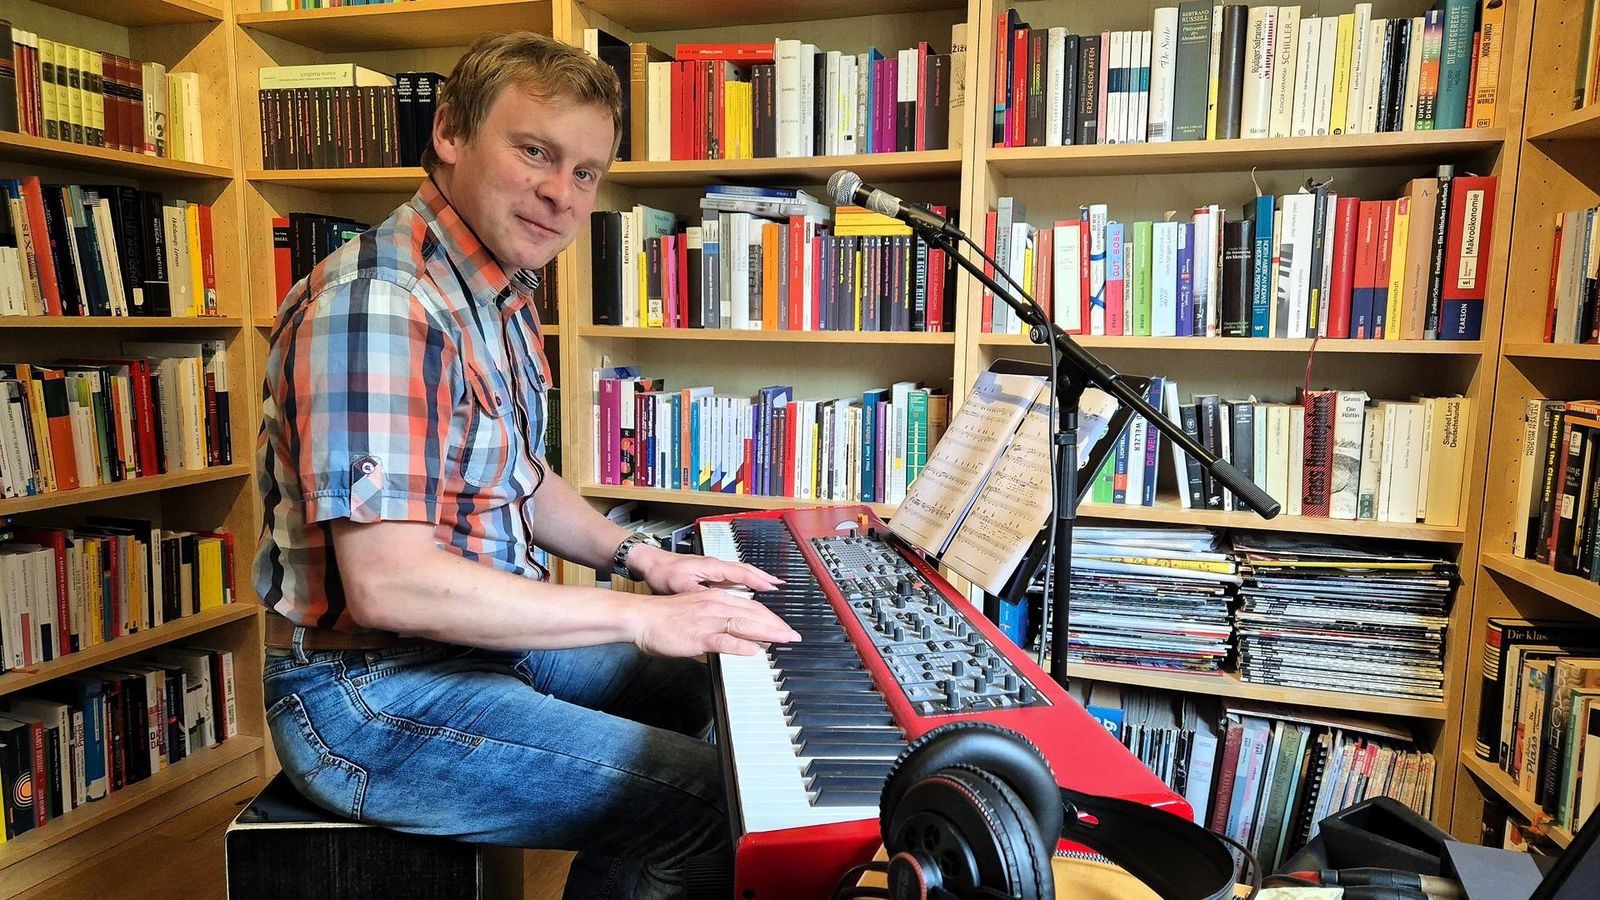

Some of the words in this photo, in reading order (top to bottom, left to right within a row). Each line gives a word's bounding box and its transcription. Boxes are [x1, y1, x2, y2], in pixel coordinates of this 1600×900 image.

[1182, 9, 1210, 17] BERTRAND
[1182, 15, 1209, 23] RUSSELL
[1252, 20, 1263, 50] Safranski
[1448, 6, 1460, 51] AUFGEREGTE
[1457, 6, 1470, 58] GESELLSCHAFT
[1483, 23, 1492, 41] COMIC
[1281, 22, 1293, 65] SCHILLER
[1481, 42, 1490, 58] BOOK
[1088, 47, 1096, 69] AFFEN
[1251, 50, 1263, 74] Rüdiger
[1446, 51, 1456, 65] DIE
[1440, 183, 1449, 209] Lehrbuch
[153, 217, 161, 245] MUSICAL
[1438, 209, 1447, 235] kritisches
[1465, 193, 1480, 255] Makroökonomie
[1112, 261, 1120, 276] GUT
[1434, 249, 1443, 275] Evolution
[1390, 280, 1400, 334] Literaturwissenschaft
[1431, 276, 1440, 314] Junker/Scherer
[1458, 303, 1468, 334] PEARSON
[1341, 412, 1361, 420] Rättin
[1345, 407, 1356, 415] Die
[1445, 402, 1453, 417] Lenz
[1442, 417, 1452, 445] Siegfried
[1449, 402, 1460, 448] Deutschstunde
[1549, 414, 1560, 448] Rocking
[1148, 429, 1157, 452] NEUE
[1529, 430, 1537, 456] WILSON
[1146, 453, 1155, 467] DIE
[1548, 450, 1556, 465] the
[1544, 467, 1554, 502] Classics
[1507, 629, 1523, 640] Die
[1527, 735, 1539, 775] Plass
